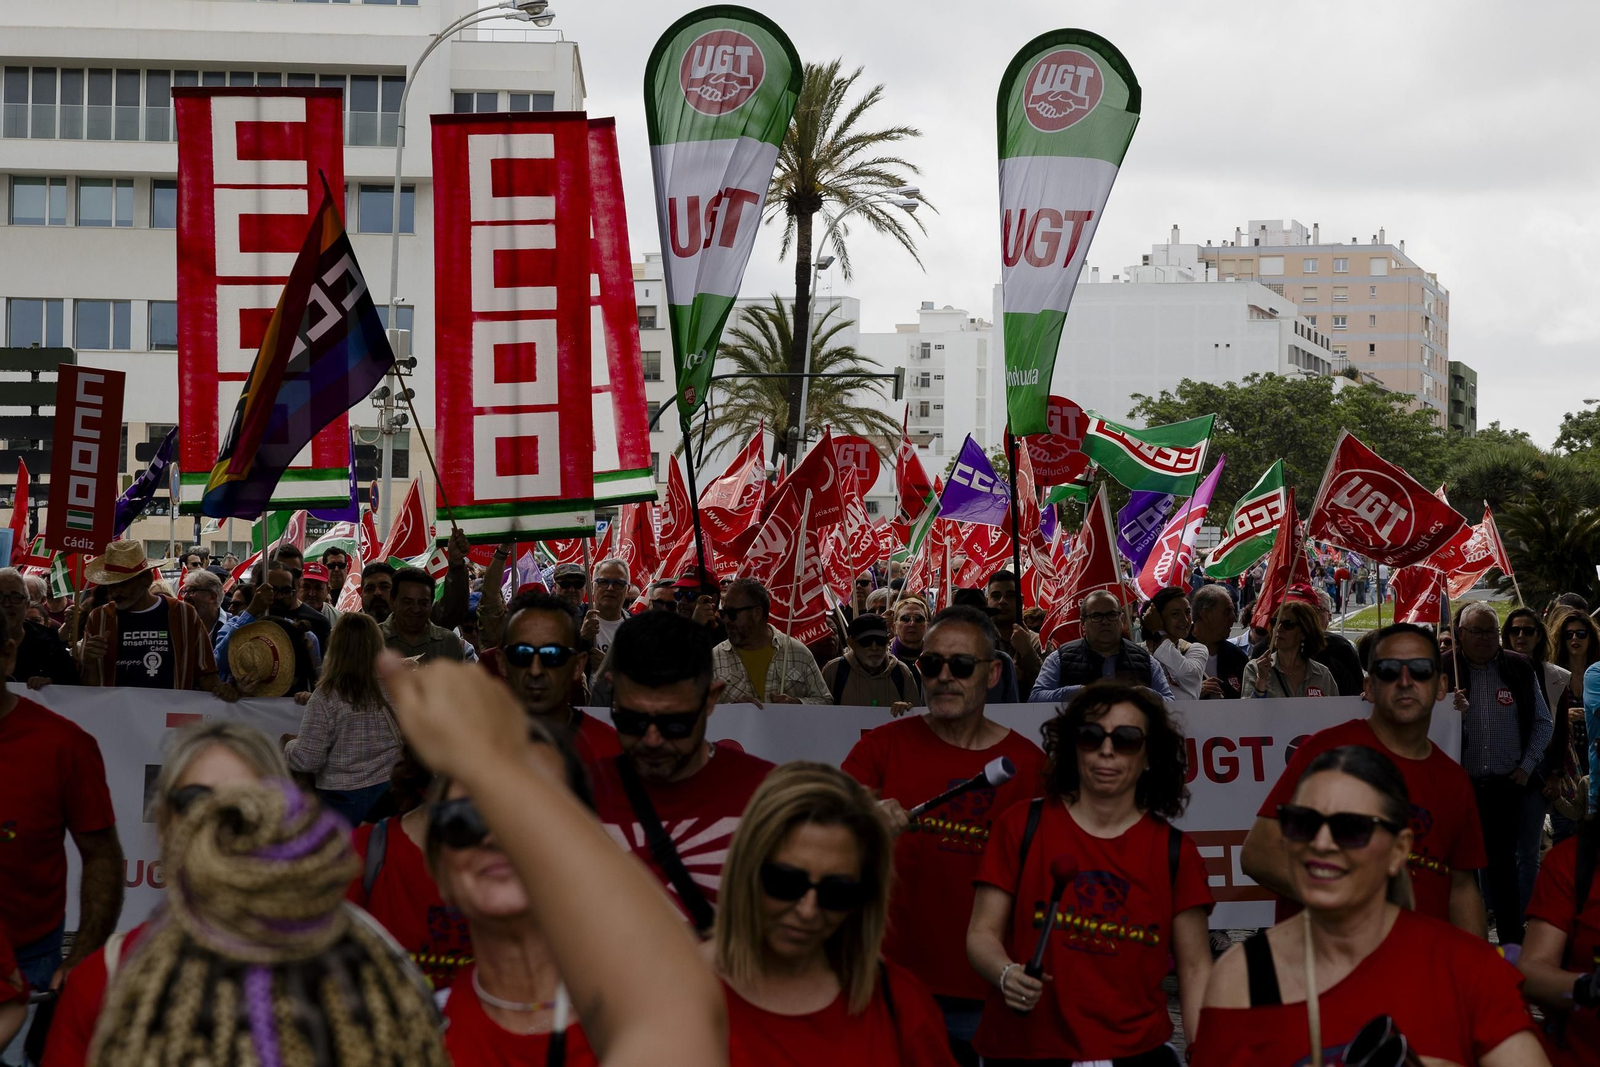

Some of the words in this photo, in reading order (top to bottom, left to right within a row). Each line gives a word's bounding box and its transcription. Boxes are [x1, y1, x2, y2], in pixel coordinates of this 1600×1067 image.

[691, 45, 754, 77] UGT
[1032, 63, 1094, 97] UGT
[1003, 207, 1095, 269] UGT
[468, 133, 562, 500] CCOO
[1047, 405, 1081, 441] GT
[68, 371, 105, 508] CCOO
[1033, 465, 1071, 476] ndalucía
[1332, 475, 1409, 547] UGT
[63, 535, 95, 551] Cádiz
[470, 547, 494, 558] Anda
[122, 638, 169, 647] enseñanza
[123, 630, 158, 640] CCOO
[116, 659, 142, 671] empre
